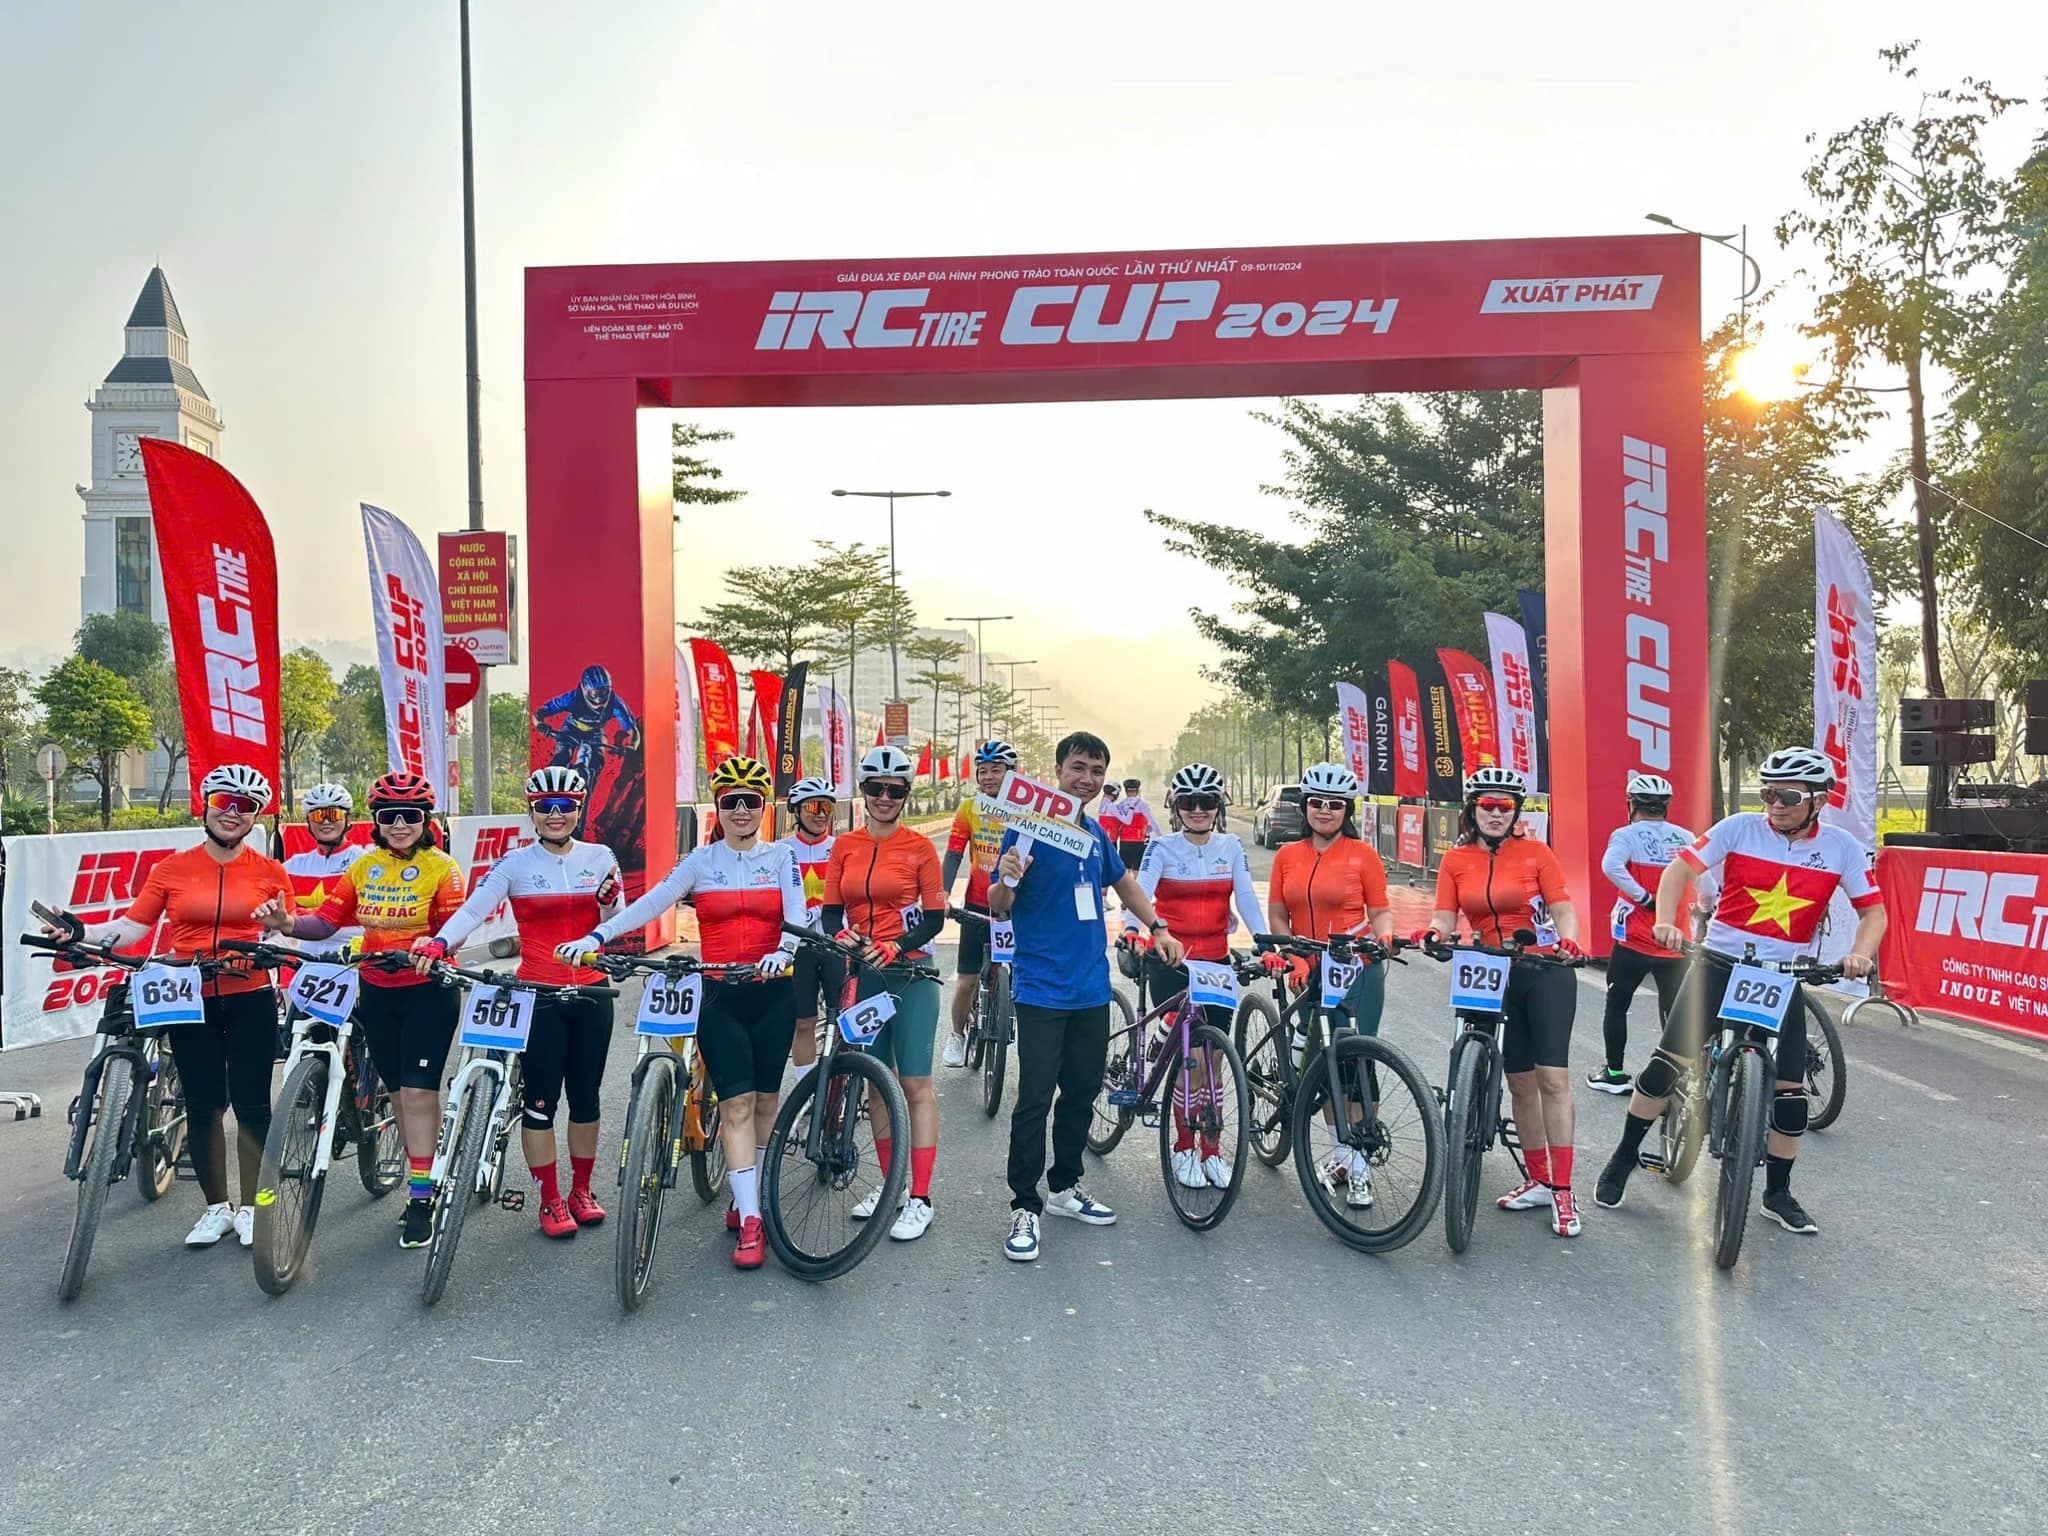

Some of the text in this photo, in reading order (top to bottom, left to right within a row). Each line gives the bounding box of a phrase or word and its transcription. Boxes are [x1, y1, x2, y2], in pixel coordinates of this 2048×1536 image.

[837, 255, 1302, 283] GIẢI ĐUA XE ĐẠP ĐỊA HÌNH PHONG TRÀO TOÀN QUỐC LẦN THỨ NHẤT 09-10/11/2024
[634, 302, 655, 310] THAO
[656, 301, 667, 309] VÀ
[681, 300, 699, 310] LỊCH
[1501, 278, 1644, 304] XUẤT PHÁT
[625, 324, 635, 332] XE
[916, 311, 988, 347] TIRE
[1000, 279, 1221, 345] CUP
[1215, 297, 1400, 339] 2024
[611, 332, 632, 340] THAO
[634, 330, 649, 341] VIỆT
[651, 331, 670, 339] NAM
[449, 556, 497, 569] CỘNG HÒA
[459, 542, 486, 553] NƯỚC
[212, 542, 251, 606] TIRE
[448, 582, 498, 595] CHỦ NGHĨA
[457, 569, 489, 582] XÃ HỘI
[1624, 553, 1652, 606] TIRE
[444, 612, 471, 623] MUÔN
[474, 611, 497, 623] NĂM
[451, 598, 496, 611] VIỆT NAM
[386, 572, 414, 671] CUP
[411, 597, 428, 676] 2024
[404, 675, 417, 706] TIRE
[1502, 650, 1522, 709] CUP
[1519, 665, 1533, 713] 2024
[1625, 612, 1671, 772] CUP
[1405, 696, 1417, 721] TIRE
[1430, 685, 1444, 753] TUAN BIKER
[1348, 706, 1361, 743] CUP
[1375, 696, 1389, 772] GARMIN
[1006, 777, 1073, 819] DTP
[1038, 826, 1063, 843] CAO
[1063, 836, 1085, 853] MỚI
[386, 903, 417, 918] BẮC
[1458, 964, 1502, 992] 629
[1942, 957, 1970, 975] CÔNG
[1971, 963, 1984, 978] TY
[1985, 965, 2012, 984] TNHH
[2014, 972, 2038, 989] CAO
[142, 976, 194, 1006] 634
[296, 973, 350, 1008] 521
[648, 987, 695, 1016] 506
[1733, 979, 1782, 1009] 626
[1939, 979, 2002, 1007] INOUE
[2007, 994, 2031, 1015] VIỆT
[471, 999, 521, 1029] 501
